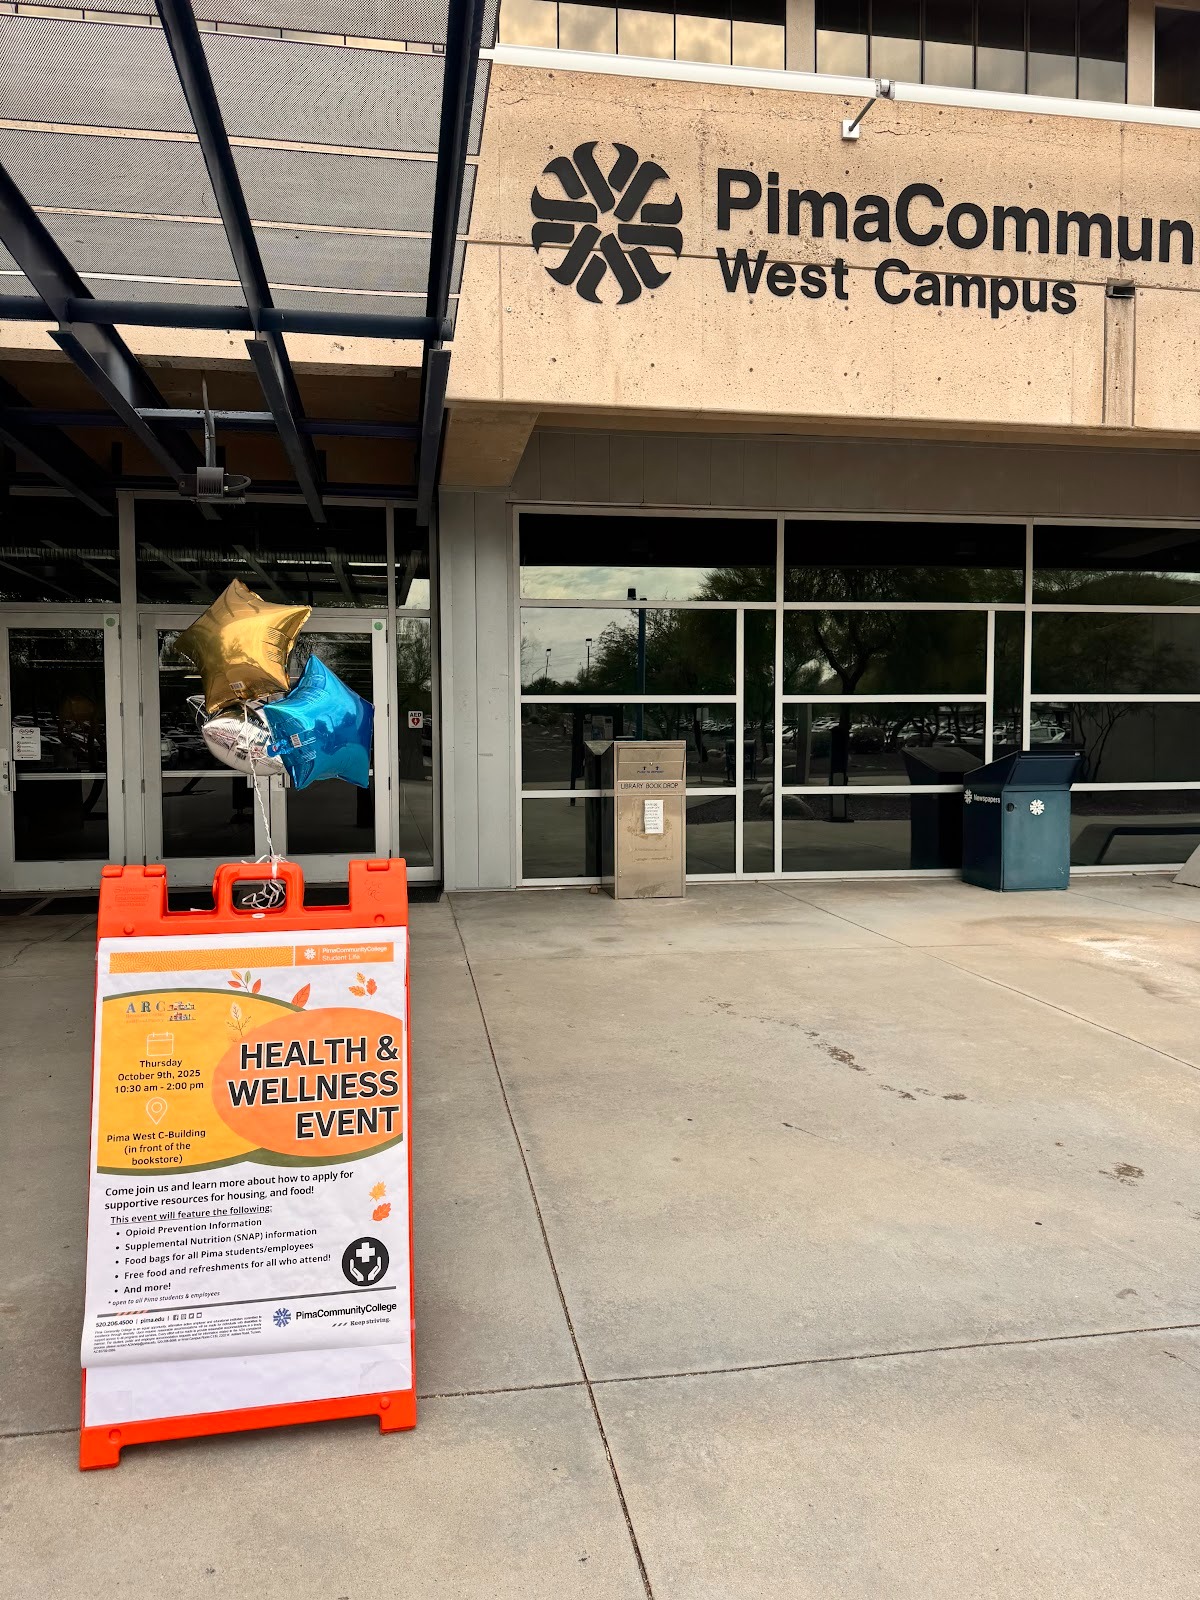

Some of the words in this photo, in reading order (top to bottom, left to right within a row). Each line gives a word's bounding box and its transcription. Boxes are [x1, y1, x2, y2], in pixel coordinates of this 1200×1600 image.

[717, 167, 1194, 265] PimaCommun
[717, 246, 848, 301] West
[874, 256, 1077, 319] Campus
[974, 794, 1000, 803] Newspapers
[322, 945, 388, 954] PimaCommunityCollege
[240, 1037, 367, 1072] HEALTH
[376, 1035, 398, 1061] &
[140, 1059, 183, 1068] Thursday
[118, 1072, 154, 1081] October
[157, 1070, 175, 1080] 9th,
[177, 1069, 200, 1078] 2025
[115, 1084, 141, 1094] 10:30
[166, 1082, 187, 1091] 2:00
[189, 1082, 204, 1091] pm
[228, 1070, 398, 1108] WELLNESS
[296, 1106, 400, 1140] EVENT
[106, 1134, 130, 1142] Pima
[132, 1132, 156, 1141] West
[158, 1129, 206, 1139] C-Building
[124, 1145, 136, 1155] (in
[140, 1144, 162, 1152] front
[164, 1142, 174, 1151] of
[176, 1142, 191, 1150] the
[132, 1154, 183, 1166] bookstore)
[105, 1188, 134, 1196] Come
[135, 1185, 155, 1196] join
[171, 1182, 190, 1192] and
[192, 1181, 216, 1190] learn
[219, 1179, 245, 1188] more
[247, 1176, 276, 1186] about
[278, 1175, 298, 1183] how
[300, 1174, 310, 1182] to
[312, 1171, 338, 1182] apply
[340, 1170, 354, 1178] for
[104, 1198, 159, 1211] supportive
[161, 1195, 208, 1205] resources
[211, 1193, 225, 1201] for
[227, 1190, 267, 1200] housing,
[270, 1188, 288, 1197] and
[290, 1186, 314, 1195] food!
[111, 1216, 129, 1224] This
[131, 1213, 157, 1222] event
[159, 1211, 175, 1220] will
[178, 1210, 210, 1219] feature
[213, 1207, 228, 1215] the
[126, 1227, 155, 1237] Opioid
[158, 1222, 207, 1234] Prevention
[209, 1219, 262, 1230] Information
[125, 1238, 188, 1252] Supplemental
[190, 1235, 231, 1245] Nutrition
[233, 1232, 263, 1243] (SNAP)
[265, 1228, 317, 1239] information
[124, 1256, 147, 1265] Food
[149, 1254, 170, 1264] bags
[172, 1253, 185, 1261] for
[188, 1251, 199, 1259] all
[201, 1249, 223, 1258] Pima
[225, 1243, 314, 1257] students/employees
[124, 1272, 144, 1280] Free
[146, 1268, 167, 1278] food
[169, 1267, 187, 1275] and
[188, 1262, 249, 1273] refreshments
[266, 1259, 277, 1267] all
[279, 1257, 297, 1266] who
[299, 1254, 331, 1264] attend!
[123, 1285, 142, 1294] And
[144, 1282, 171, 1292] more!
[135, 1296, 143, 1304] all
[159, 1293, 184, 1302] students
[190, 1291, 220, 1299] employees
[296, 1303, 397, 1320] PimaCommunityCollege
[95, 1320, 133, 1328] 520.206.4500
[140, 1316, 165, 1324] pima.edu
